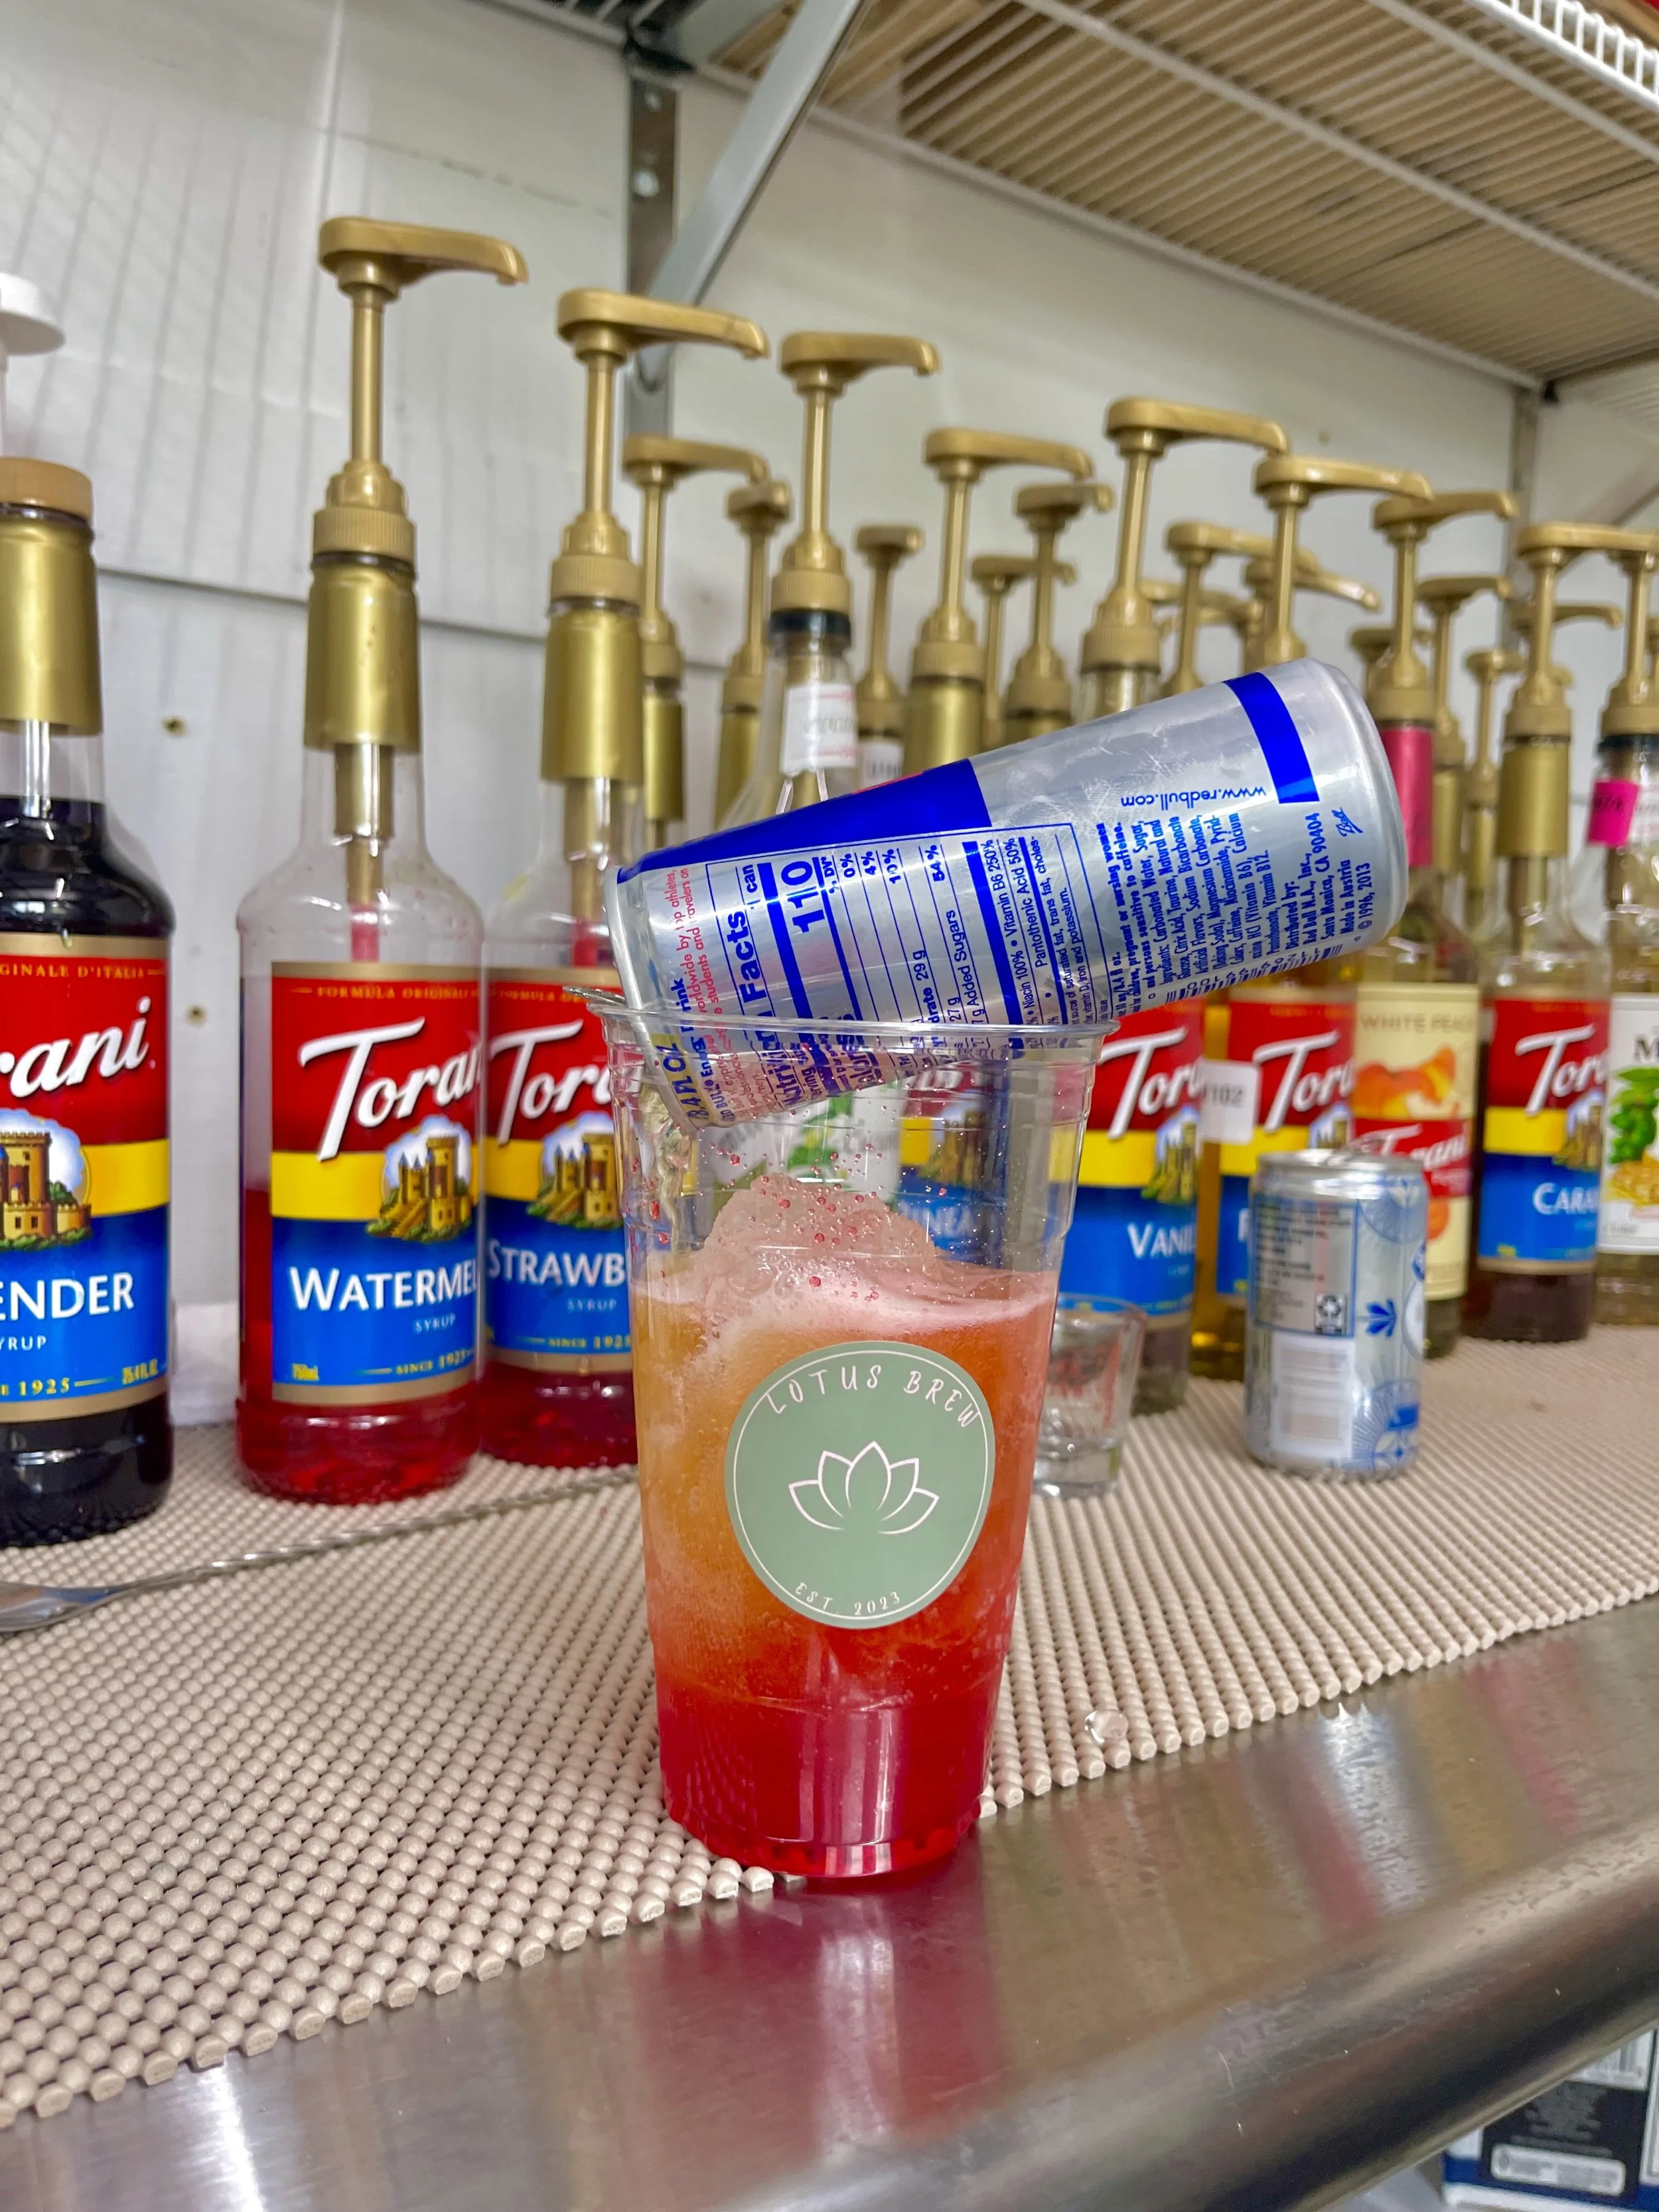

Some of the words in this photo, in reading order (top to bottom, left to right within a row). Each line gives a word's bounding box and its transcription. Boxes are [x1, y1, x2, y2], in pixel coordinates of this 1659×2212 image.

[1121, 787, 1263, 810] www.redbull.com
[1131, 821, 1148, 853] Sugar,
[1144, 820, 1163, 837] and
[1189, 816, 1210, 867] Carbonate,
[1204, 818, 1225, 844] Pyrid-
[1228, 814, 1246, 853] Calcium
[1306, 813, 1327, 853] 90404
[981, 840, 1001, 871] 250%
[1004, 838, 1021, 864] 50%
[1031, 836, 1046, 873] choles-
[1096, 823, 1114, 863] women
[1114, 822, 1133, 871] caffeine.
[1169, 817, 1192, 874] Bicarbonate
[840, 853, 855, 877] 0%
[861, 851, 876, 875] 4%
[882, 849, 901, 883] 10%
[925, 845, 945, 881] 54%
[1149, 839, 1173, 875] Natural
[1236, 857, 1254, 880] B6),
[1253, 850, 1271, 872] B12.
[1298, 853, 1312, 879] Inc.,
[1315, 855, 1329, 872] CA
[681, 869, 688, 878] on
[743, 865, 757, 893] can
[991, 875, 1005, 891] B6
[1011, 867, 1030, 893] Acid
[1126, 875, 1137, 887] to
[1141, 855, 1157, 889] Water,
[1214, 846, 1238, 906] Niacinamide,
[1337, 860, 1354, 898] Austria
[1356, 863, 1372, 890] 2013
[664, 870, 679, 907] athletes,
[781, 861, 825, 932] 110
[1040, 878, 1052, 895] fat,
[1108, 865, 1125, 907] nursing
[1165, 875, 1181, 915] Taurine,
[1183, 877, 1200, 912] Sodium
[1202, 868, 1224, 919] Magnesium
[1260, 873, 1277, 908] Vitamin
[1281, 881, 1299, 901] by:
[1301, 881, 1316, 909] N.A.,
[1319, 875, 1334, 915] Monica,
[998, 893, 1017, 937] Vitamin
[1047, 899, 1060, 926] trans
[1060, 886, 1083, 944] potassium.
[1119, 911, 1128, 921] or
[1130, 891, 1147, 937] sensitive
[1242, 883, 1262, 922] (Vitamin
[1341, 901, 1354, 911] in
[1358, 893, 1375, 919] 1996,
[1143, 891, 1167, 942] Carbonated
[1167, 913, 1186, 934] Acid,
[1190, 913, 1206, 946] Flavors,
[1226, 907, 1243, 942] Caffeine,
[1281, 901, 1299, 950] Distributed
[1301, 911, 1317, 928] Bull
[1321, 917, 1334, 939] Santa
[1340, 912, 1354, 934] Made
[676, 935, 691, 950] by
[687, 928, 703, 950] and
[946, 907, 972, 962] Sugars
[1021, 899, 1047, 967] Pantothenic
[1053, 929, 1064, 945] fat,
[1174, 934, 1188, 954] Citric
[1208, 920, 1225, 945] Soda),
[1265, 907, 1281, 955] Pantothenate,
[1303, 929, 1317, 944] Red
[727, 912, 768, 1003] Facts
[913, 948, 927, 960] g
[1071, 946, 1084, 963] and
[1120, 924, 1141, 966] pregnant
[1141, 940, 1157, 974] persons
[1213, 944, 1229, 969] (Baking
[1230, 943, 1246, 964] Colors,
[78, 965, 144, 979] D'ITALIA
[914, 964, 928, 980] 29
[1011, 951, 1028, 980] 100%
[1056, 948, 1074, 989] saturated
[1112, 952, 1121, 966] oz.
[1157, 944, 1178, 985] Ingredients:
[1176, 953, 1192, 980] Glucose,
[1192, 948, 1208, 974] Artificial
[317, 985, 396, 999] FORMULA
[698, 955, 719, 1003] students
[958, 966, 979, 1005] Added
[1079, 983, 1092, 992] D,
[1127, 968, 1141, 996] children,
[1187, 968, 1250, 990] 99100
[948, 995, 962, 1005] g
[1022, 982, 1035, 1009] Niacin
[1082, 992, 1092, 1012] vitamin
[948, 1009, 962, 1021] 27
[973, 1007, 987, 1016] g
[1361, 1013, 1426, 1030] WHITE
[490, 1238, 625, 1287] STRAWB
[413, 1313, 457, 1335] SYRUP
[396, 1361, 433, 1374] SINCE
[19, 1377, 70, 1396] 1925
[765, 1364, 882, 1414] LOTUS
[903, 1370, 979, 1427] BREW
[854, 1591, 900, 1615] 2023
